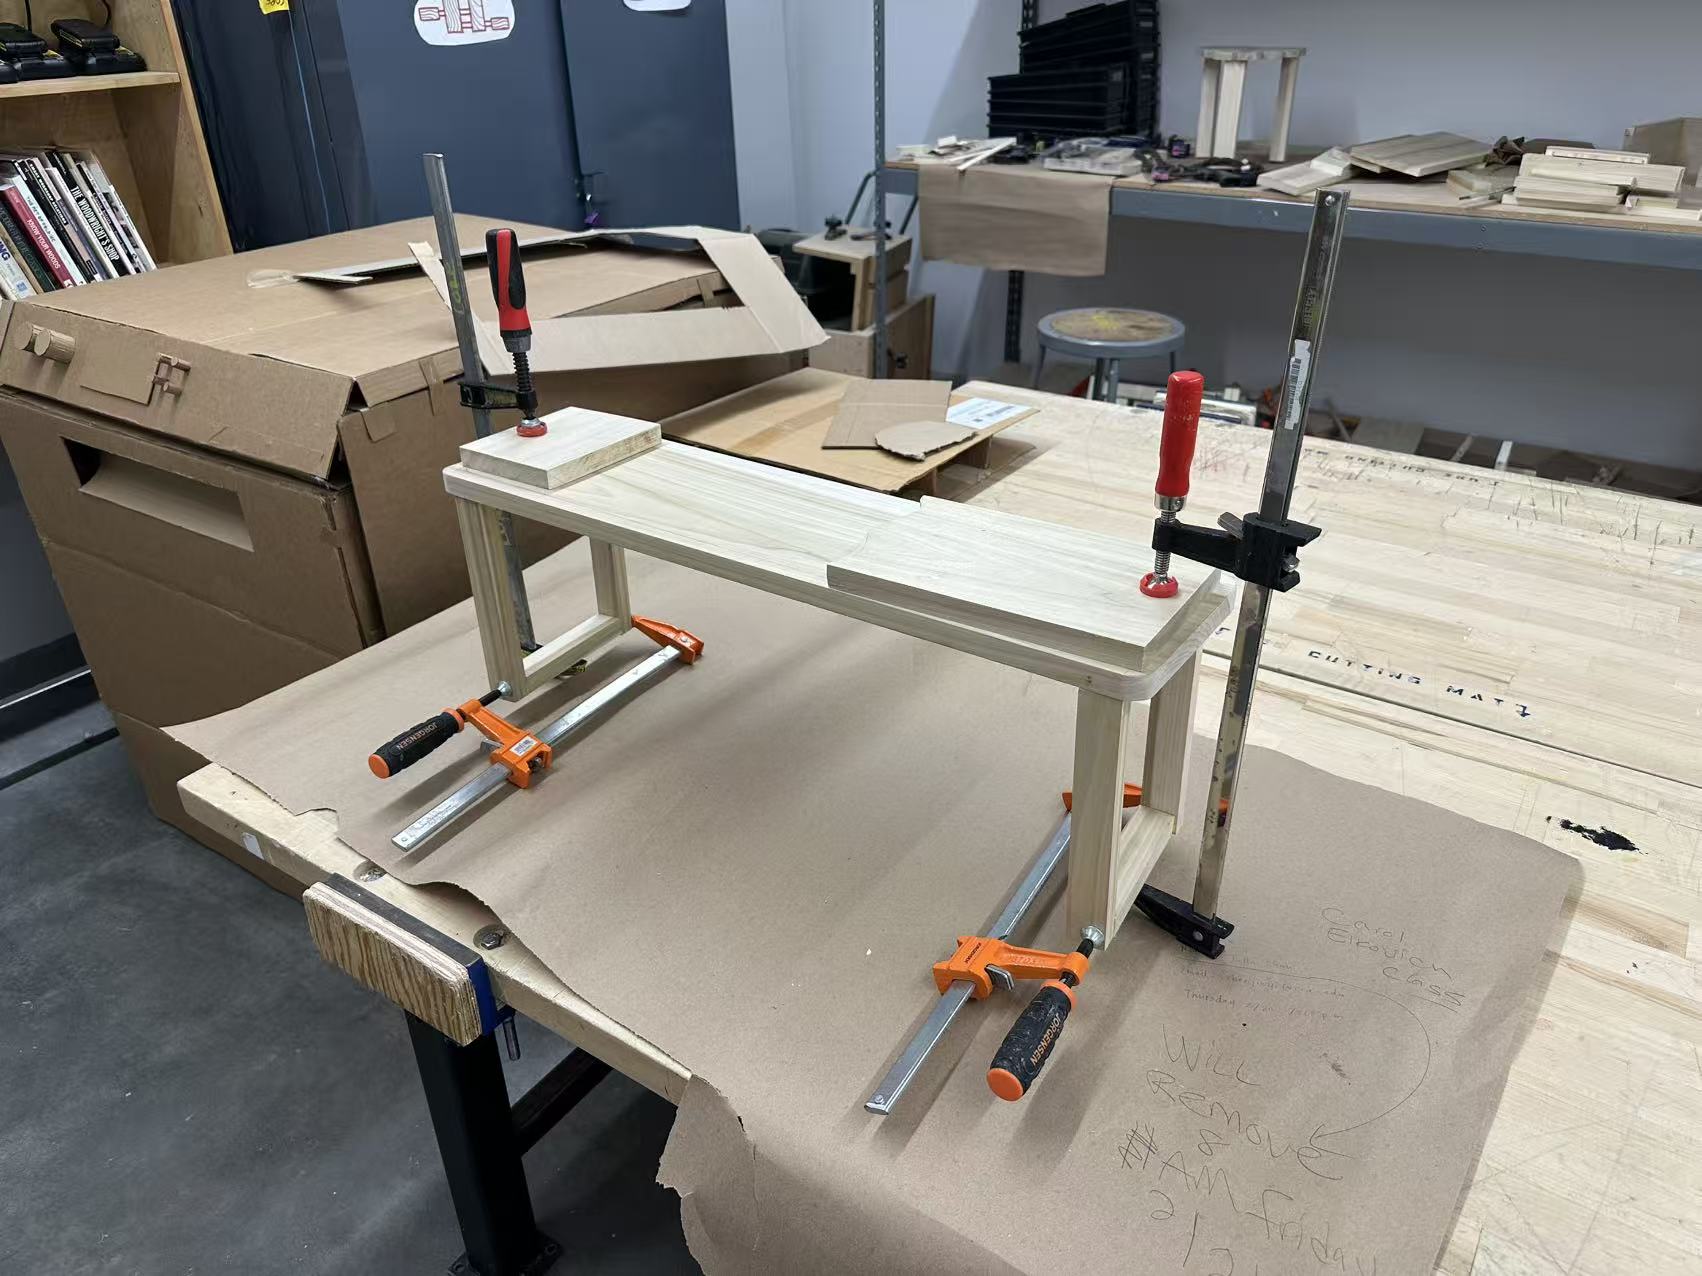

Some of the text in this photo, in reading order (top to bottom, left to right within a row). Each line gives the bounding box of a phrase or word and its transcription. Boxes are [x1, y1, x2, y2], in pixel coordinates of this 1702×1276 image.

[27, 219, 61, 269] KNOW YOUR WOODS
[70, 185, 84, 201] THE
[78, 198, 111, 246] WOODWRIGHT'S
[104, 244, 120, 261] SHOP
[1307, 648, 1504, 706] CUTTING MAT
[396, 720, 438, 751] JORGENSEN
[1321, 907, 1405, 943] Carol
[1029, 1012, 1062, 1068] JORGENSEN
